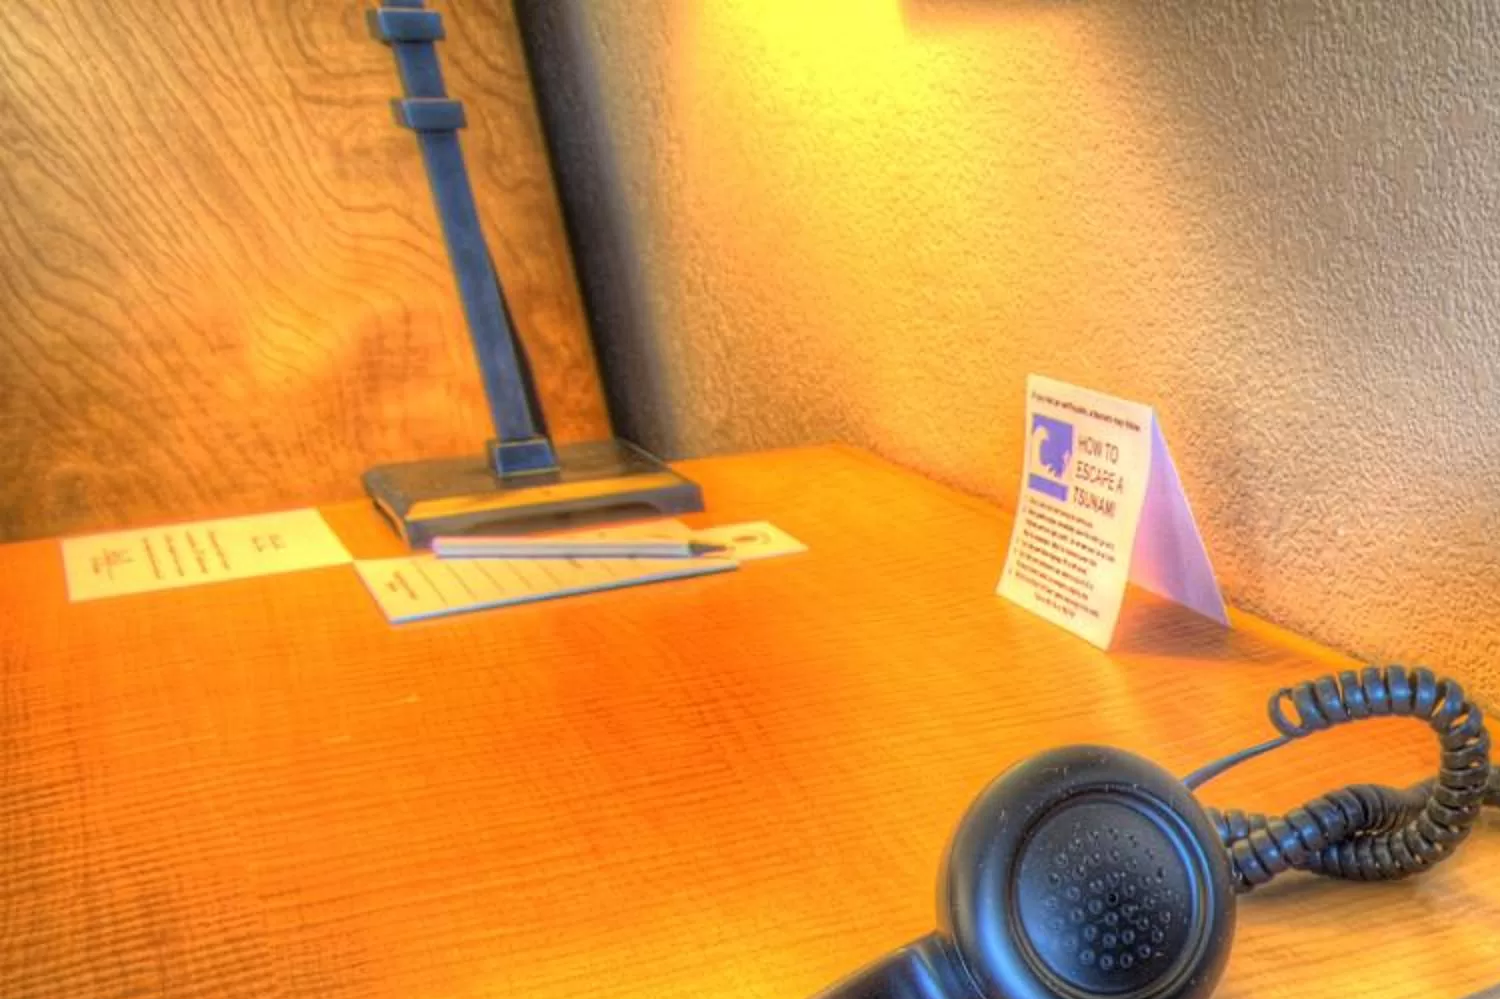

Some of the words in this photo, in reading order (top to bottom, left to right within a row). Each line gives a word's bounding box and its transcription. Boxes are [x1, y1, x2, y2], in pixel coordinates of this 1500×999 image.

[1078, 436, 1102, 458] HOW
[1104, 443, 1119, 464] TO
[1076, 461, 1116, 492] ESCAPE
[1116, 476, 1123, 494] A
